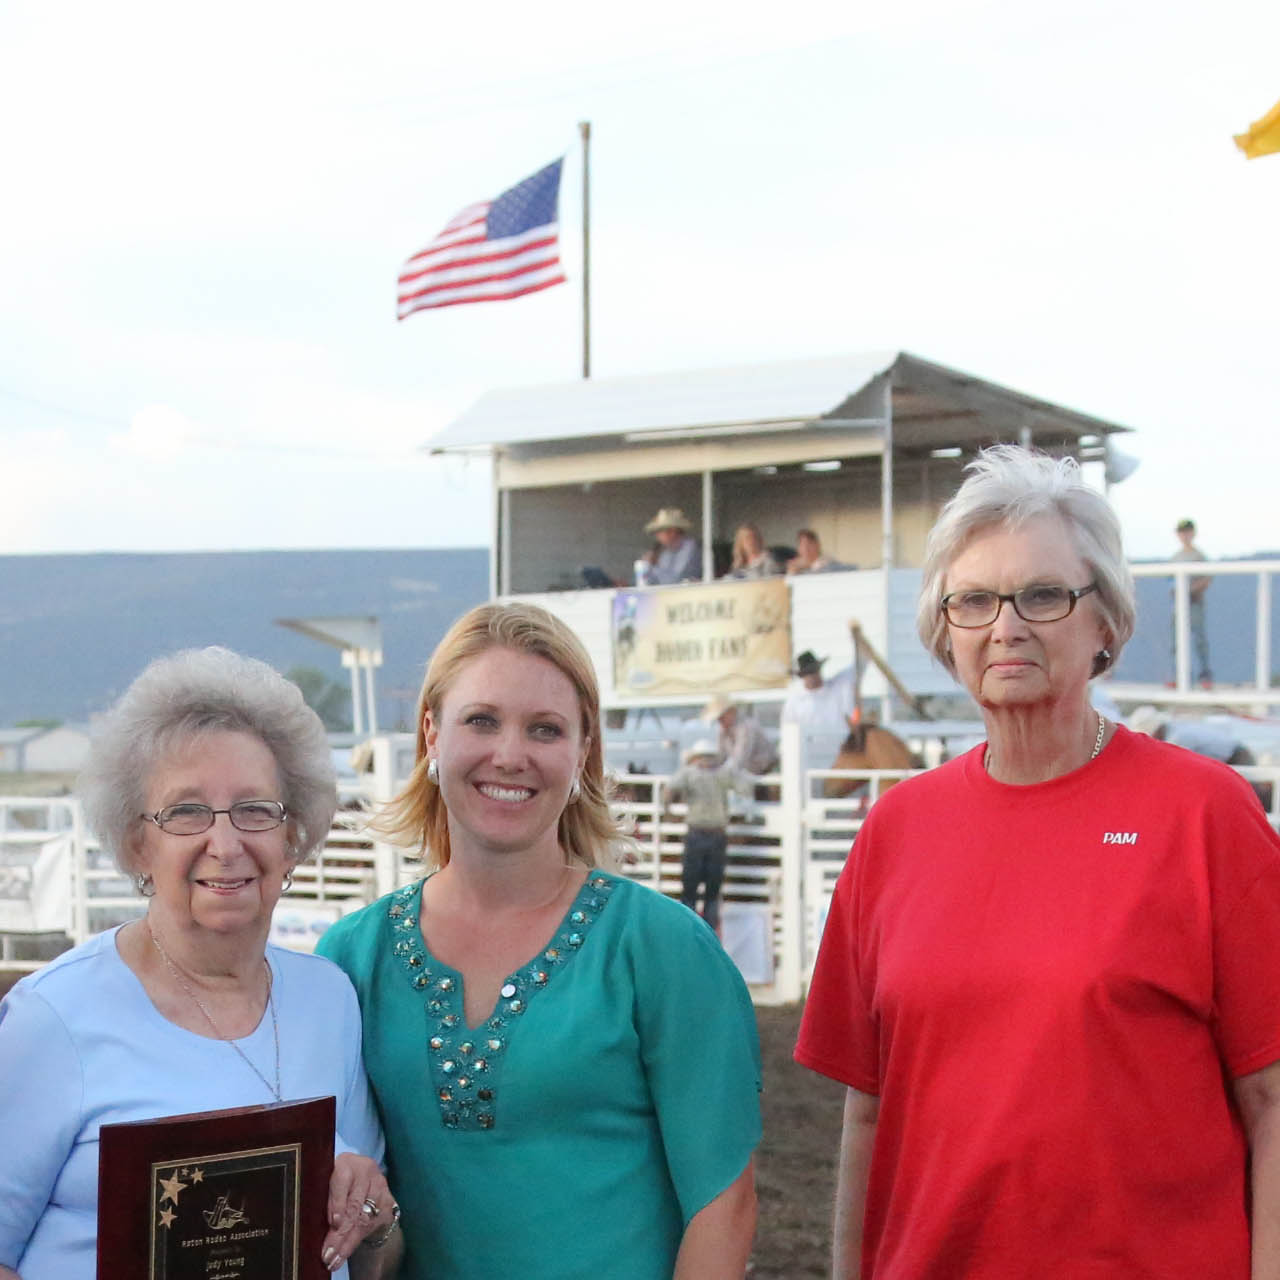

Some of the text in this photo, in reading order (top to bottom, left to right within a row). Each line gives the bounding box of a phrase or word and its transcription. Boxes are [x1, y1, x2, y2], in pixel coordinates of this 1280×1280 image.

[1103, 832, 1138, 845] PAM
[230, 1228, 269, 1241] Association
[224, 1256, 245, 1267] Young
